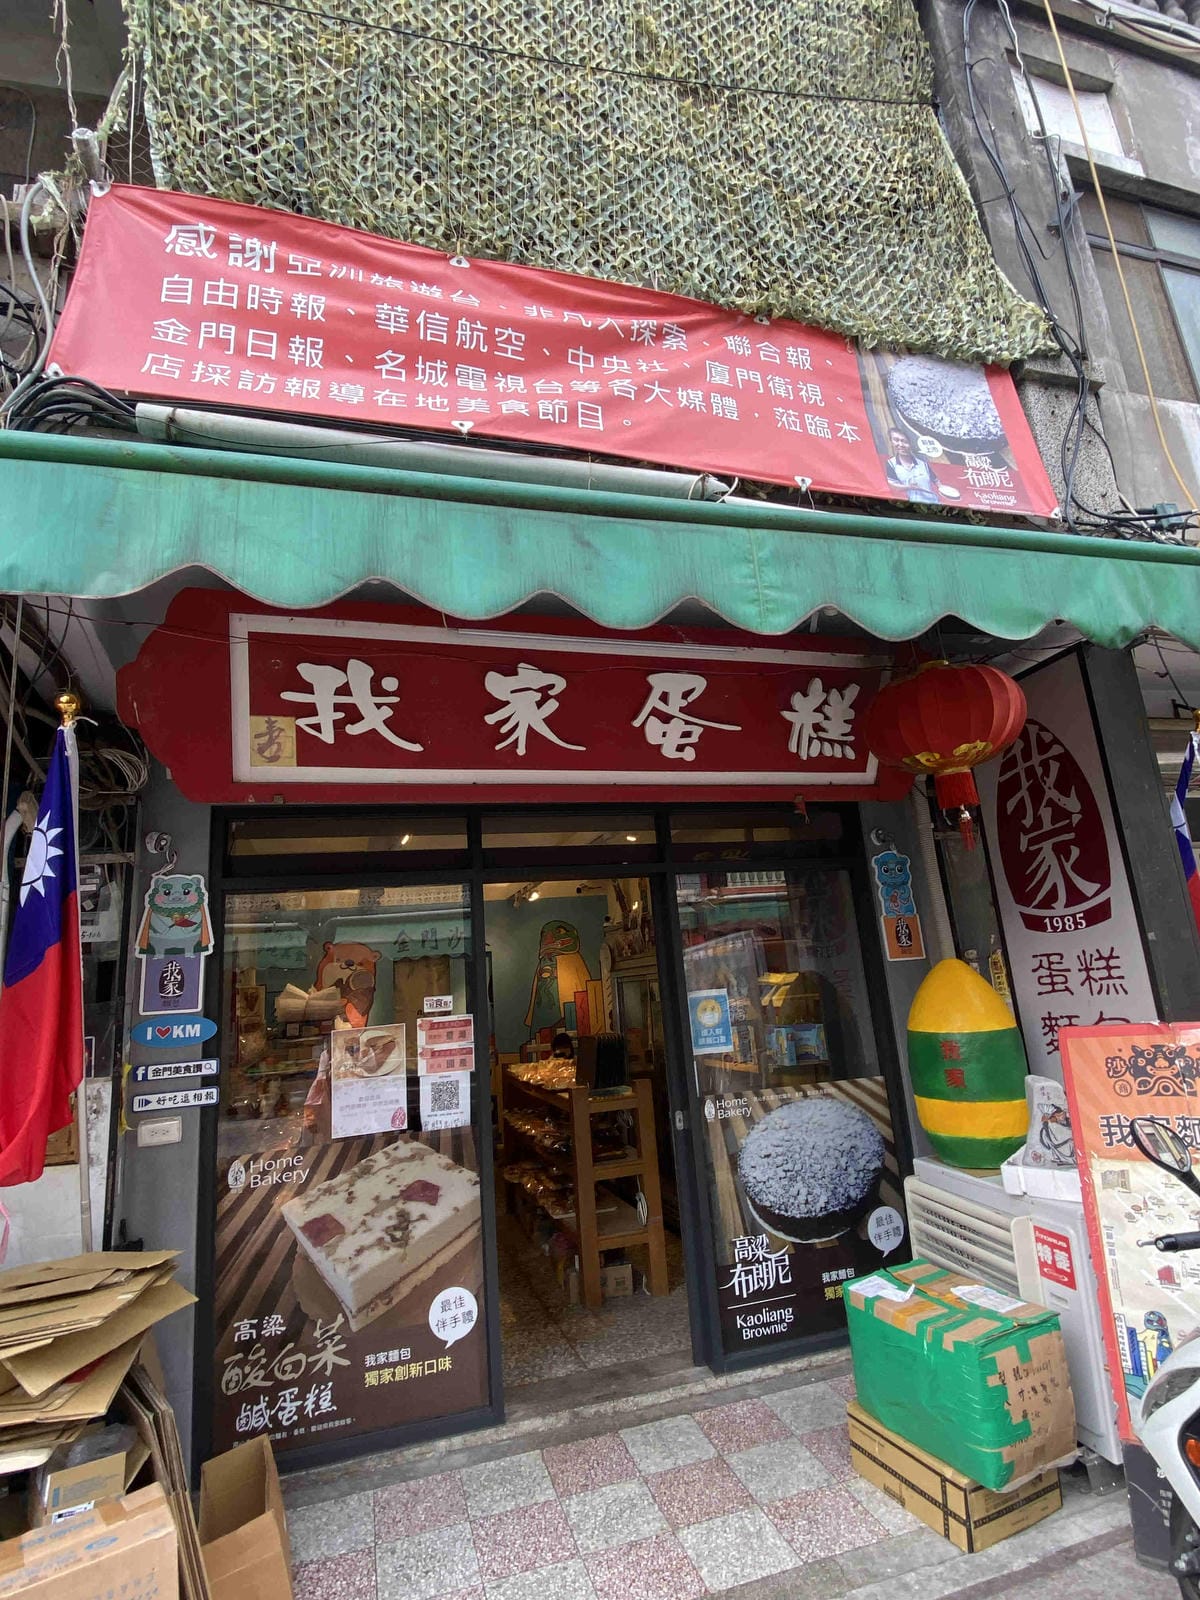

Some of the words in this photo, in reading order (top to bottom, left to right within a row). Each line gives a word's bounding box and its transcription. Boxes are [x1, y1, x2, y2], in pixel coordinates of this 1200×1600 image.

[141, 353, 633, 433] 店採訪報導在地美食節目。
[280, 658, 861, 762] 我家蛋糕
[998, 720, 1101, 911] 我家
[1043, 912, 1088, 934] 1985
[162, 961, 182, 996] 我家
[1031, 945, 1129, 998] 蛋糕
[146, 1026, 153, 1041] I
[172, 1023, 201, 1039] KM
[716, 1097, 747, 1110] Home
[718, 1106, 752, 1120] Bakery
[250, 1155, 304, 1172] Home
[250, 1167, 311, 1188] Bakery
[731, 1234, 771, 1264] 高粱
[719, 1253, 792, 1299] 布朗尼
[440, 1294, 466, 1313] 最佳
[233, 1314, 287, 1343] 高粱
[435, 1309, 475, 1333] 伴手禮
[736, 1307, 794, 1330] Kaoliang
[743, 1321, 788, 1340] Brownie
[221, 1314, 352, 1396] 酸白菜
[364, 1347, 411, 1368] 我家麵包
[364, 1355, 453, 1388] 獨家創新口味
[236, 1381, 338, 1434] 鹹蛋糕
